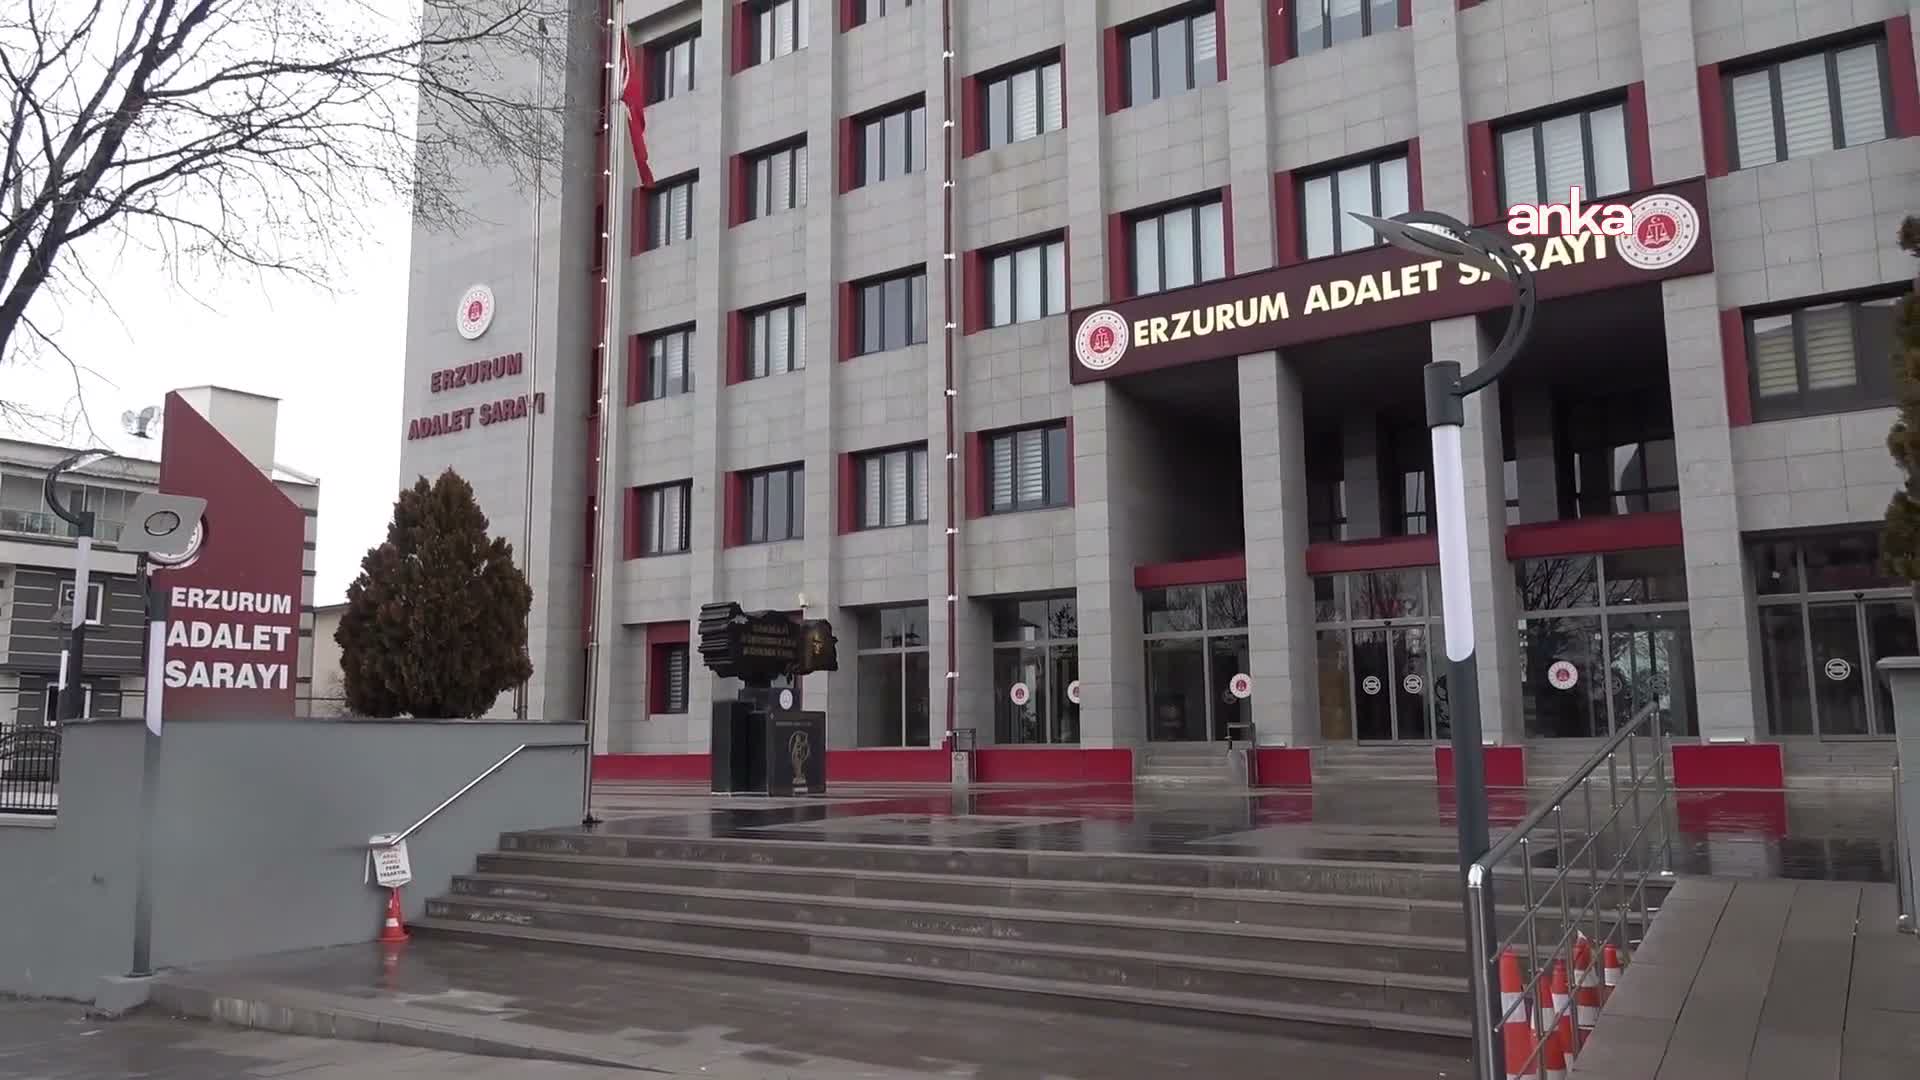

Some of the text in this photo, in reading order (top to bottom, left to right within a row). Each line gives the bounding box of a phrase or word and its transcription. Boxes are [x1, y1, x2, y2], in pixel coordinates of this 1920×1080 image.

[1133, 292, 1289, 348] ERZURUM
[1303, 260, 1443, 315] ADALET
[431, 352, 522, 394] ERZURUM
[407, 407, 474, 441] ADALET
[171, 586, 292, 615] ERZURUM
[166, 620, 292, 652] ADALET
[164, 659, 289, 690] SARAYI
